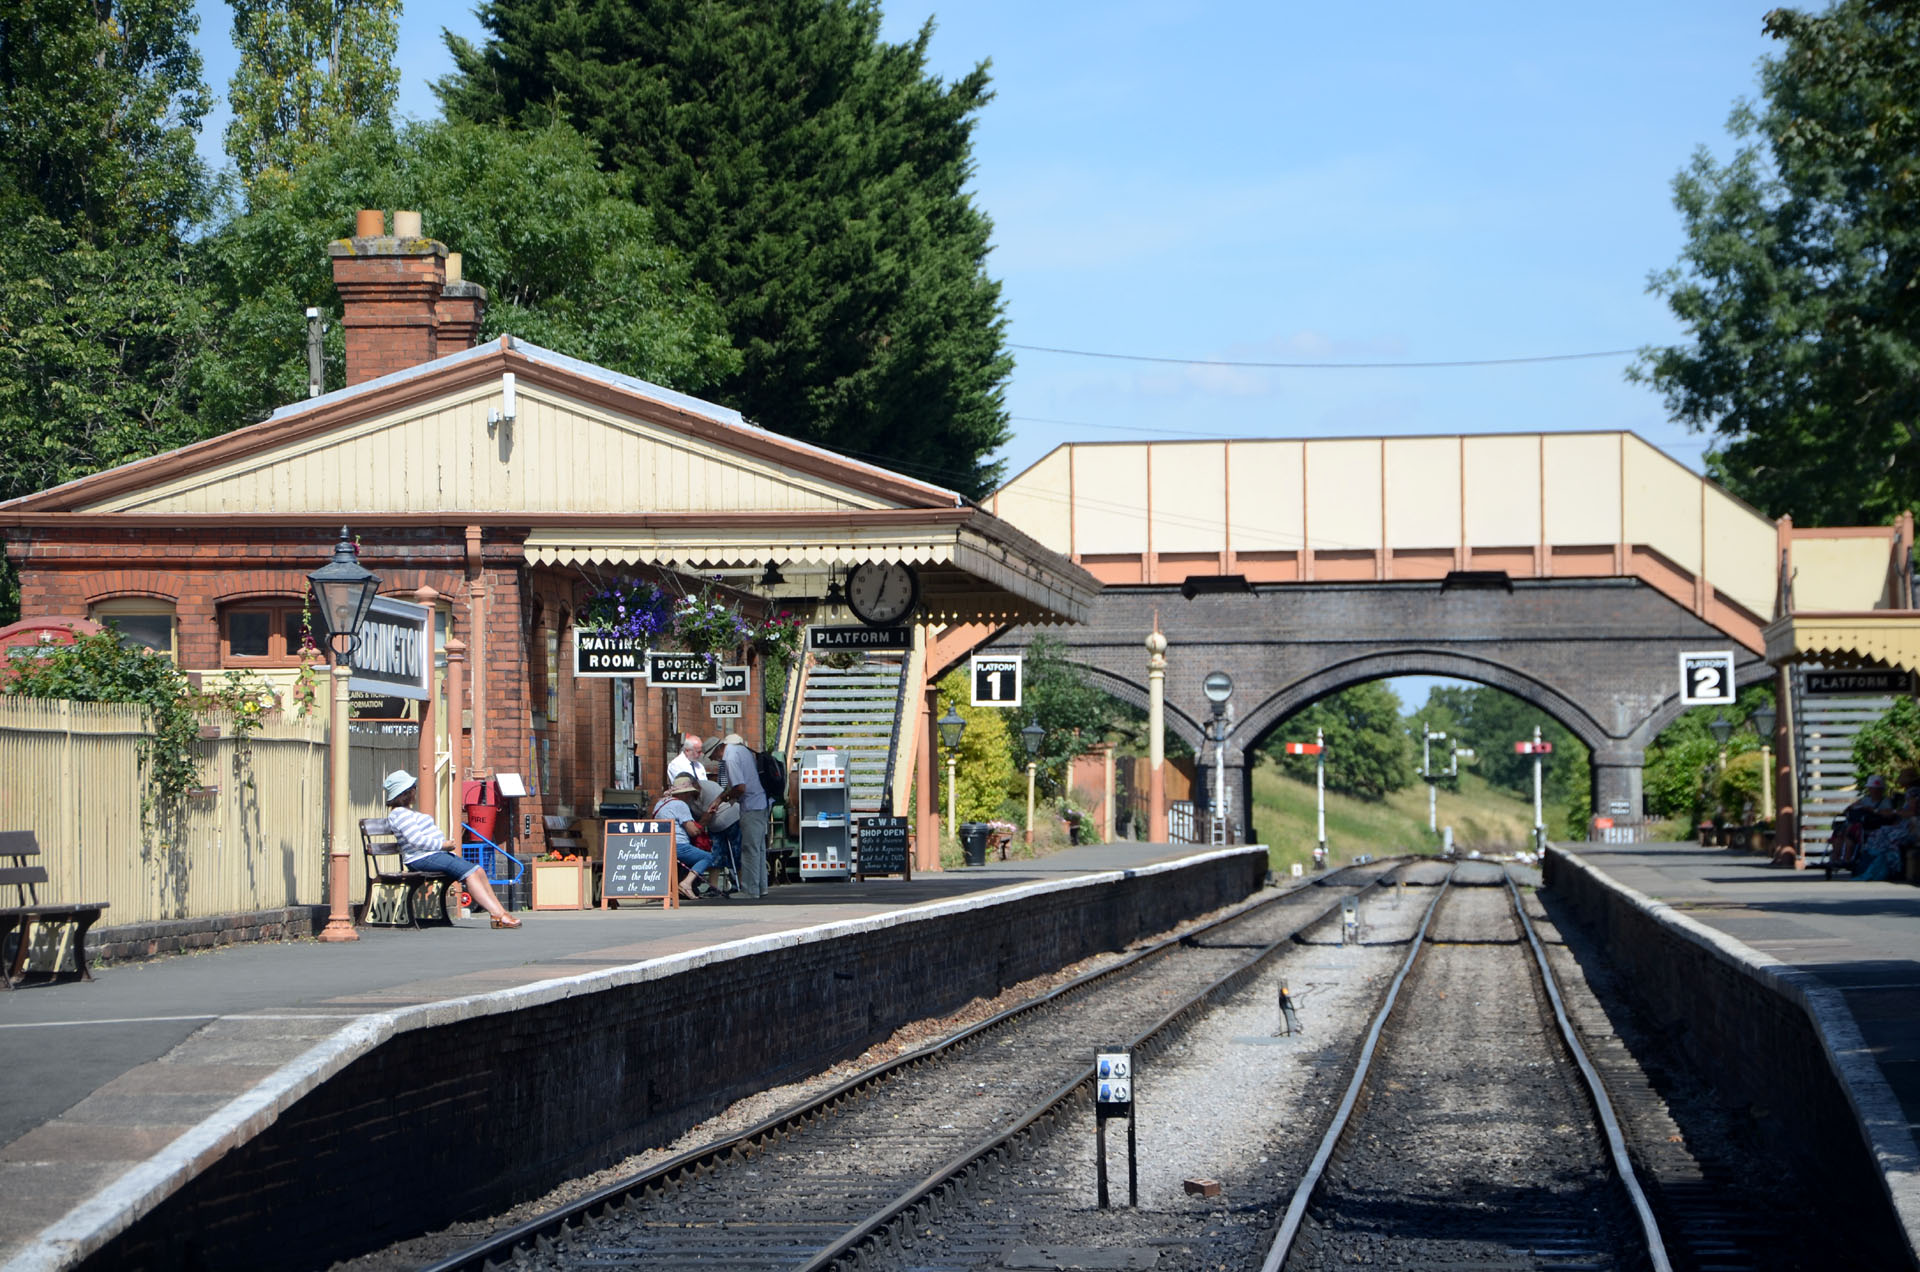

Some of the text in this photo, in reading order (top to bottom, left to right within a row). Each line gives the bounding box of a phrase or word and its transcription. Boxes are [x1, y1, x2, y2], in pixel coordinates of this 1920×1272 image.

[816, 631, 890, 644] PLATFORM
[589, 654, 635, 668] ROOM
[977, 663, 1016, 672] PLATFORM
[662, 671, 706, 680] OFFICE
[986, 671, 1001, 700] 1
[1694, 667, 1721, 698] 2
[1811, 676, 1907, 689] PLATFORM 2
[714, 705, 736, 714] OPEN
[472, 816, 487, 824] FIRE
[860, 828, 905, 837] SHOP OPEN
[629, 838, 648, 852] Light
[617, 850, 659, 862] Refreshments
[631, 860, 658, 870] available
[612, 870, 662, 882] from the buffet
[628, 882, 638, 892] the
[642, 882, 656, 892] train
